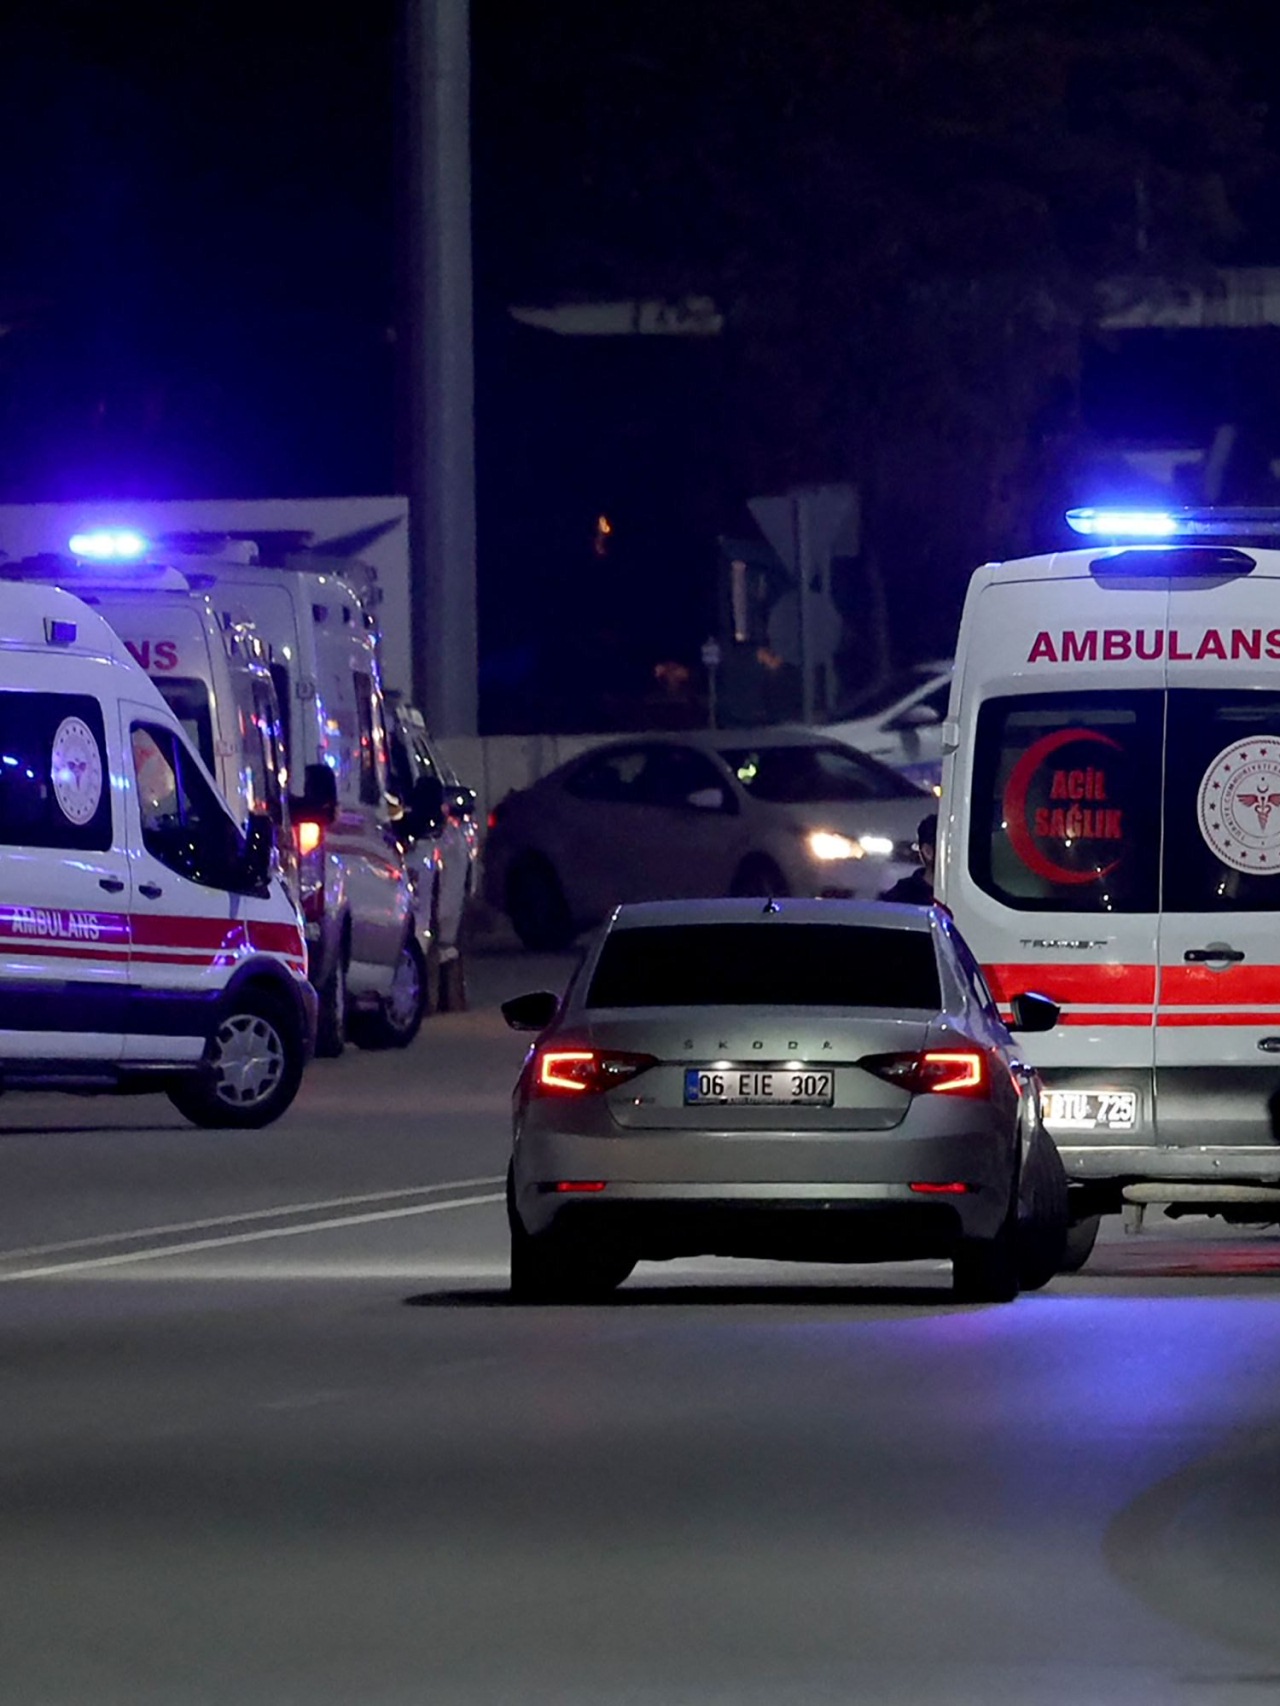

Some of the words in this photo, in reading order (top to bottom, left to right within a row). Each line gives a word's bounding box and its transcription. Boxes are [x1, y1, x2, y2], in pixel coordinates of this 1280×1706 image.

[1051, 766, 1107, 799] ACİL
[1035, 803, 1123, 838] SAĞLIK
[12, 908, 100, 940] AMBULANS
[700, 1074, 725, 1096] 06
[738, 1074, 773, 1096] EIE
[792, 1075, 829, 1097] 302
[1097, 1095, 1132, 1121] 725
